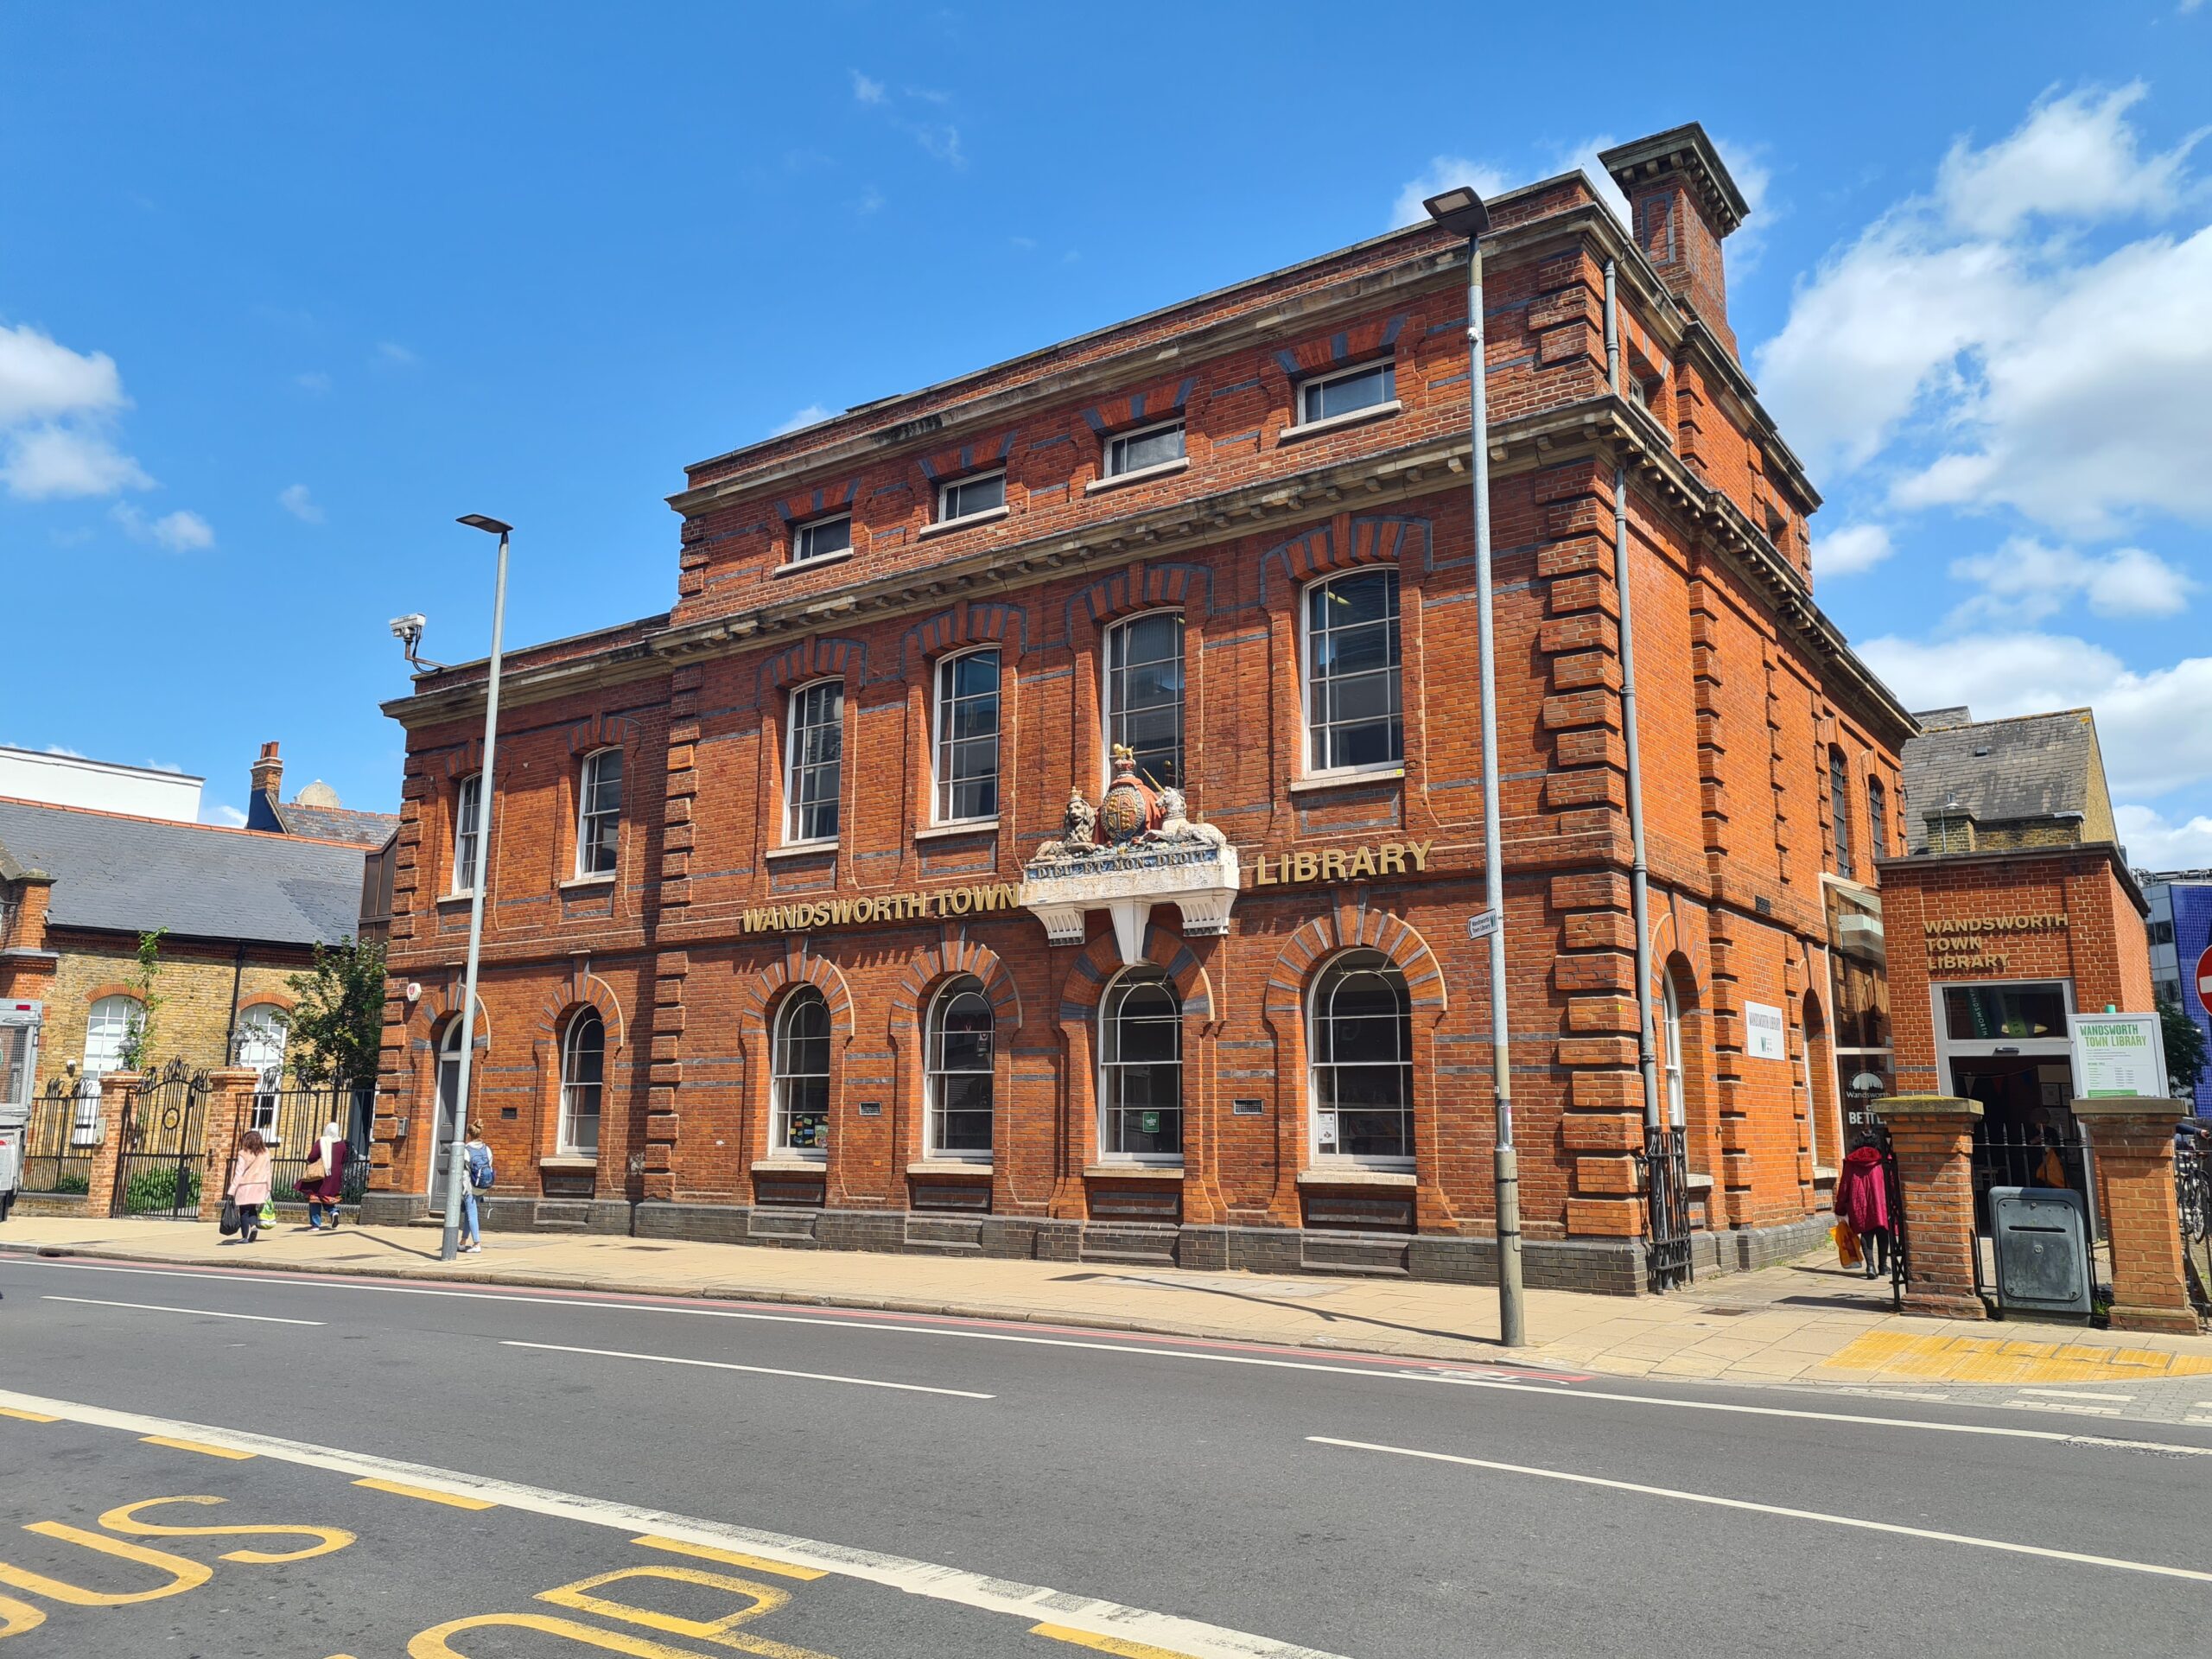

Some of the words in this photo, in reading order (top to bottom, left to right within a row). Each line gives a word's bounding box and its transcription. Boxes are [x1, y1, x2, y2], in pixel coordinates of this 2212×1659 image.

[1037, 866, 1073, 879] DIEU
[1084, 861, 1103, 874] ET
[1114, 856, 1146, 871] MON
[1157, 851, 1206, 867] DROIT
[1257, 840, 1433, 886] LIBRARY
[742, 891, 926, 933] WANDSWORTH
[936, 881, 1020, 916] TOWN
[1923, 912, 2069, 934] WANDSWORTH
[1925, 936, 1983, 952] TOWN
[1927, 953, 2010, 969] LIBRARY
[2080, 1024, 2139, 1036] WANDSWORTH
[2084, 1036, 2108, 1047] TOWN
[2111, 1035, 2146, 1047] LIBRARY
[1846, 1090, 1891, 1099] Wandsworth
[0, 1495, 359, 1638] US
